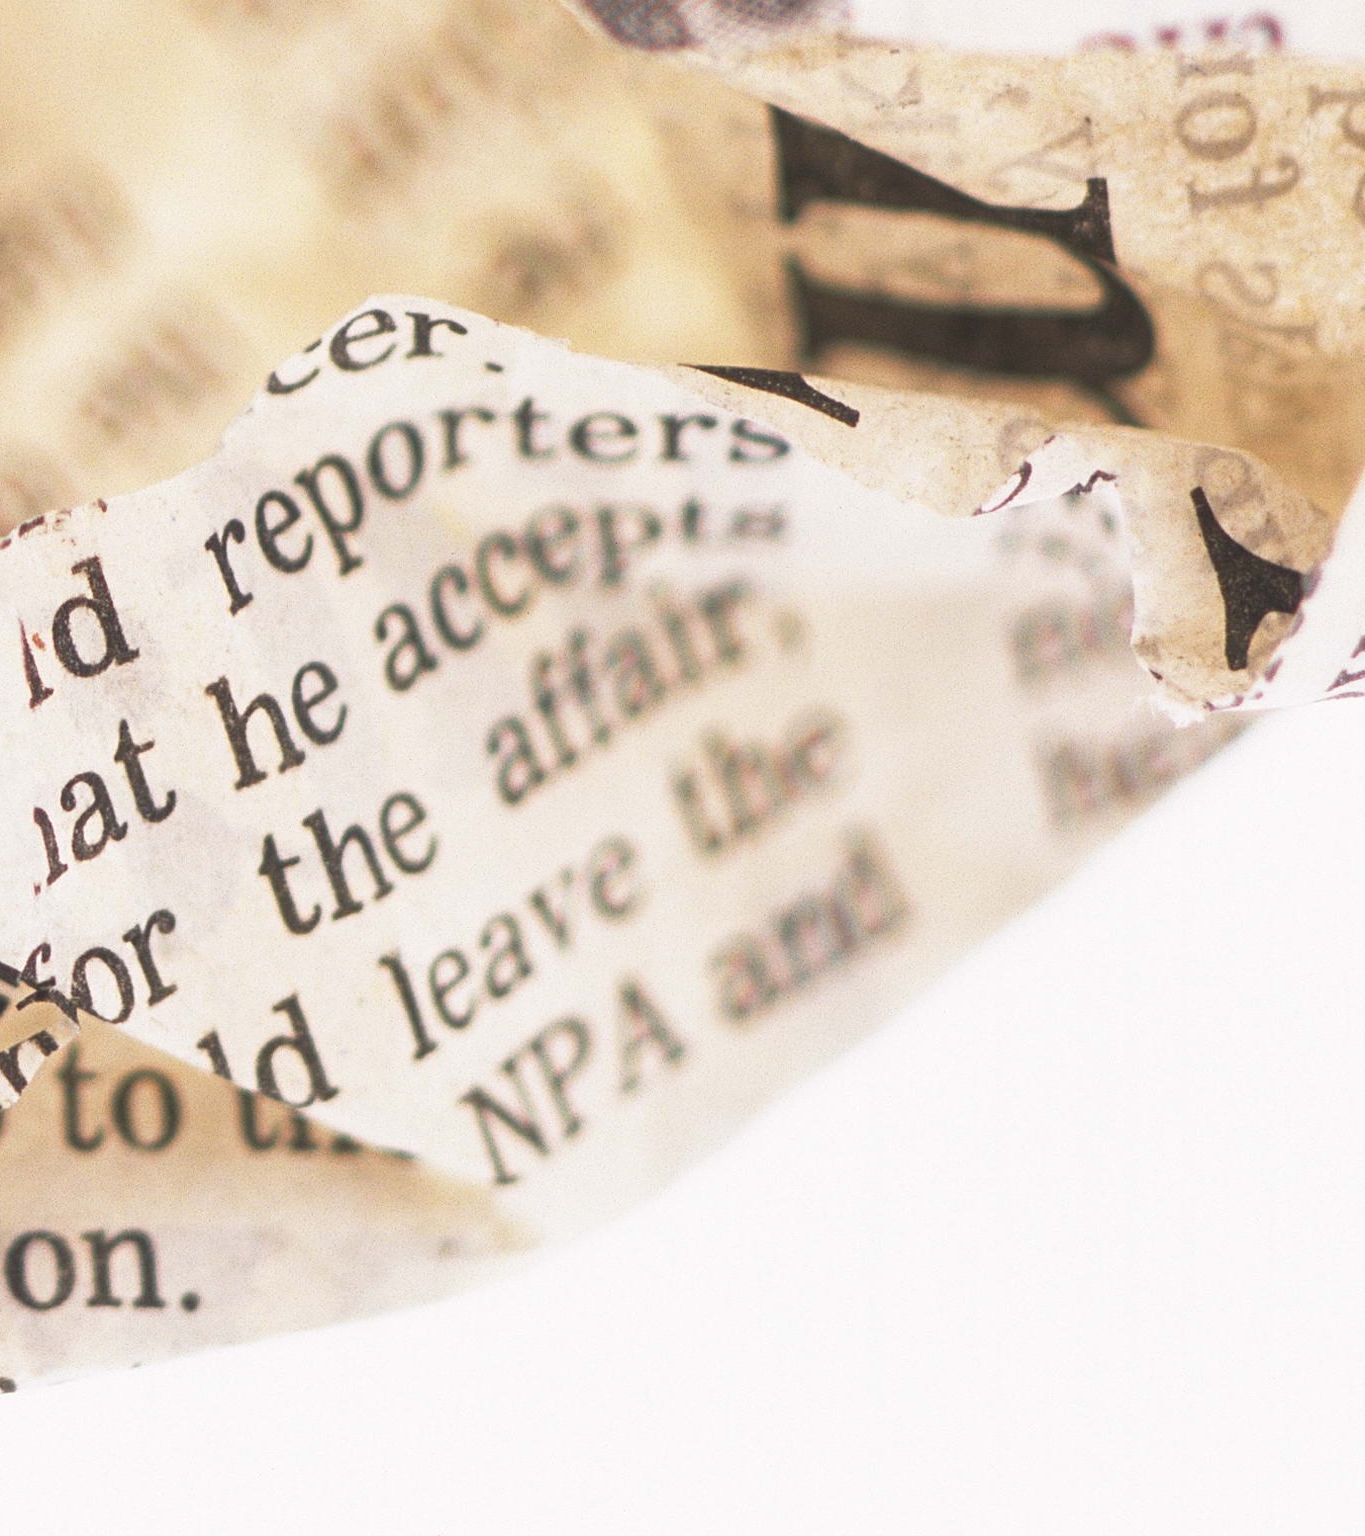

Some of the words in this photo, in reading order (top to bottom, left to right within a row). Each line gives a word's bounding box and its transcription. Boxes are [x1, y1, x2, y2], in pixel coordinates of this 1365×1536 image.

[202, 376, 792, 617] reporters
[202, 657, 351, 792] he
[372, 486, 791, 696] accepts
[257, 789, 441, 936] the
[482, 576, 809, 808] affair.
[375, 832, 645, 1064] leave
[57, 1046, 187, 1156] to
[457, 974, 689, 1188] NPA
